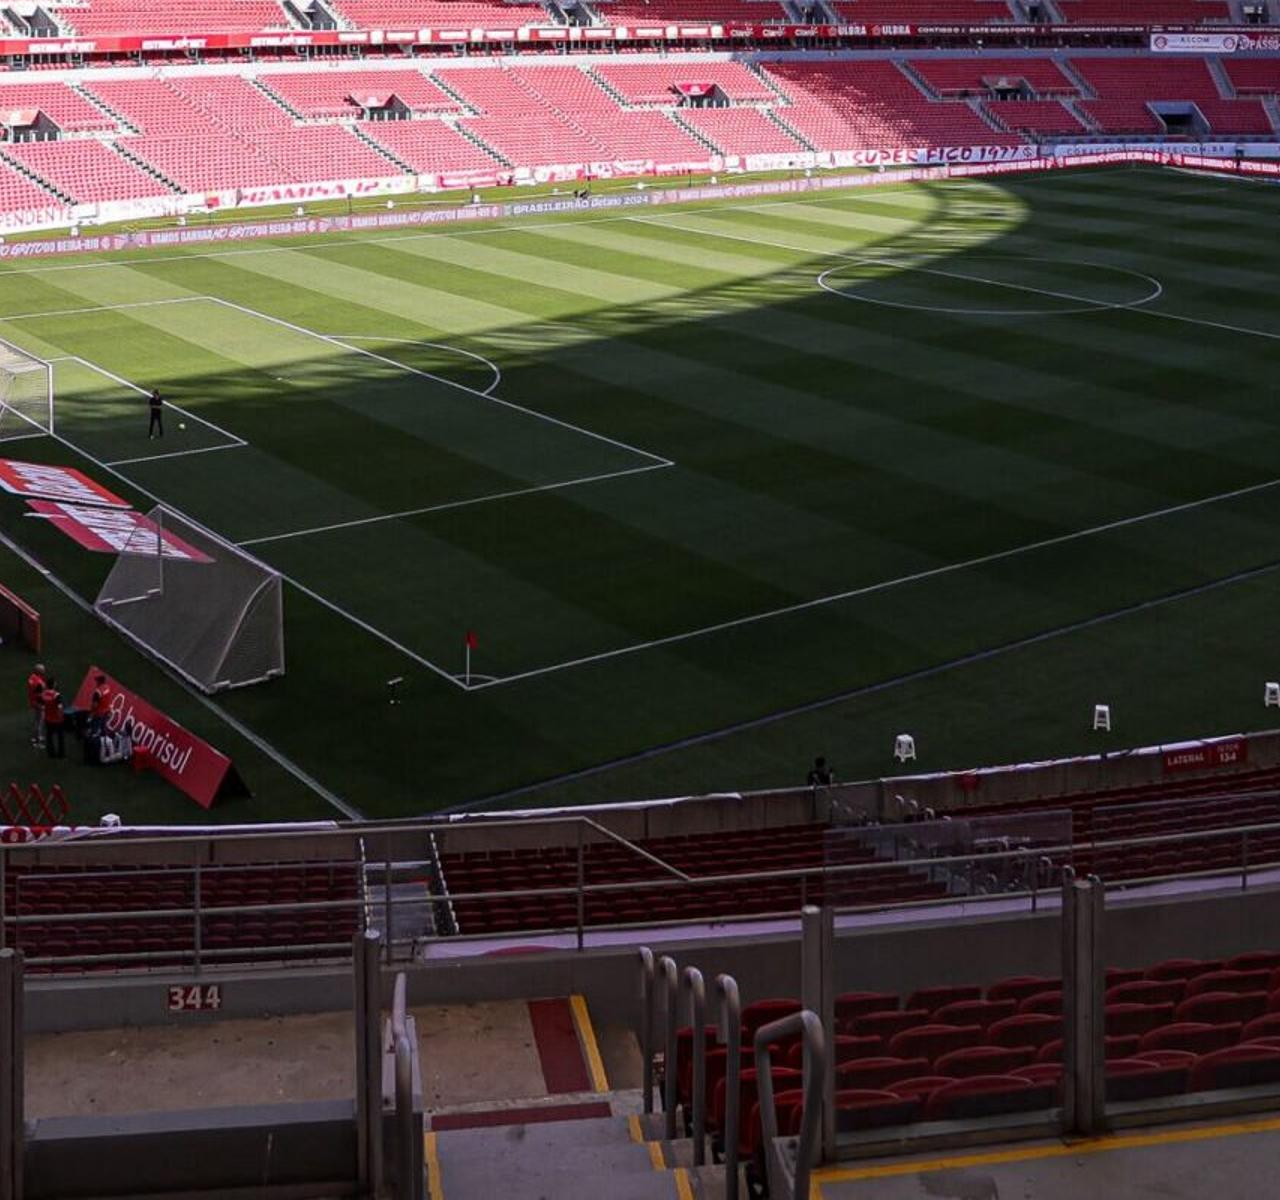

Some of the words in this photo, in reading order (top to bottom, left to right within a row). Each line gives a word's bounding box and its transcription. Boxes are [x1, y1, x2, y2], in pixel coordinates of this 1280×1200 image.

[853, 151, 919, 165] SUPER
[980, 146, 1019, 160] 1977
[623, 195, 649, 204] 2024
[10, 243, 43, 257] GRITO
[56, 237, 99, 253] BEIRA-RIO
[121, 706, 193, 774] banrisul
[1167, 751, 1204, 765] LATERAL
[169, 986, 221, 1011] 344
